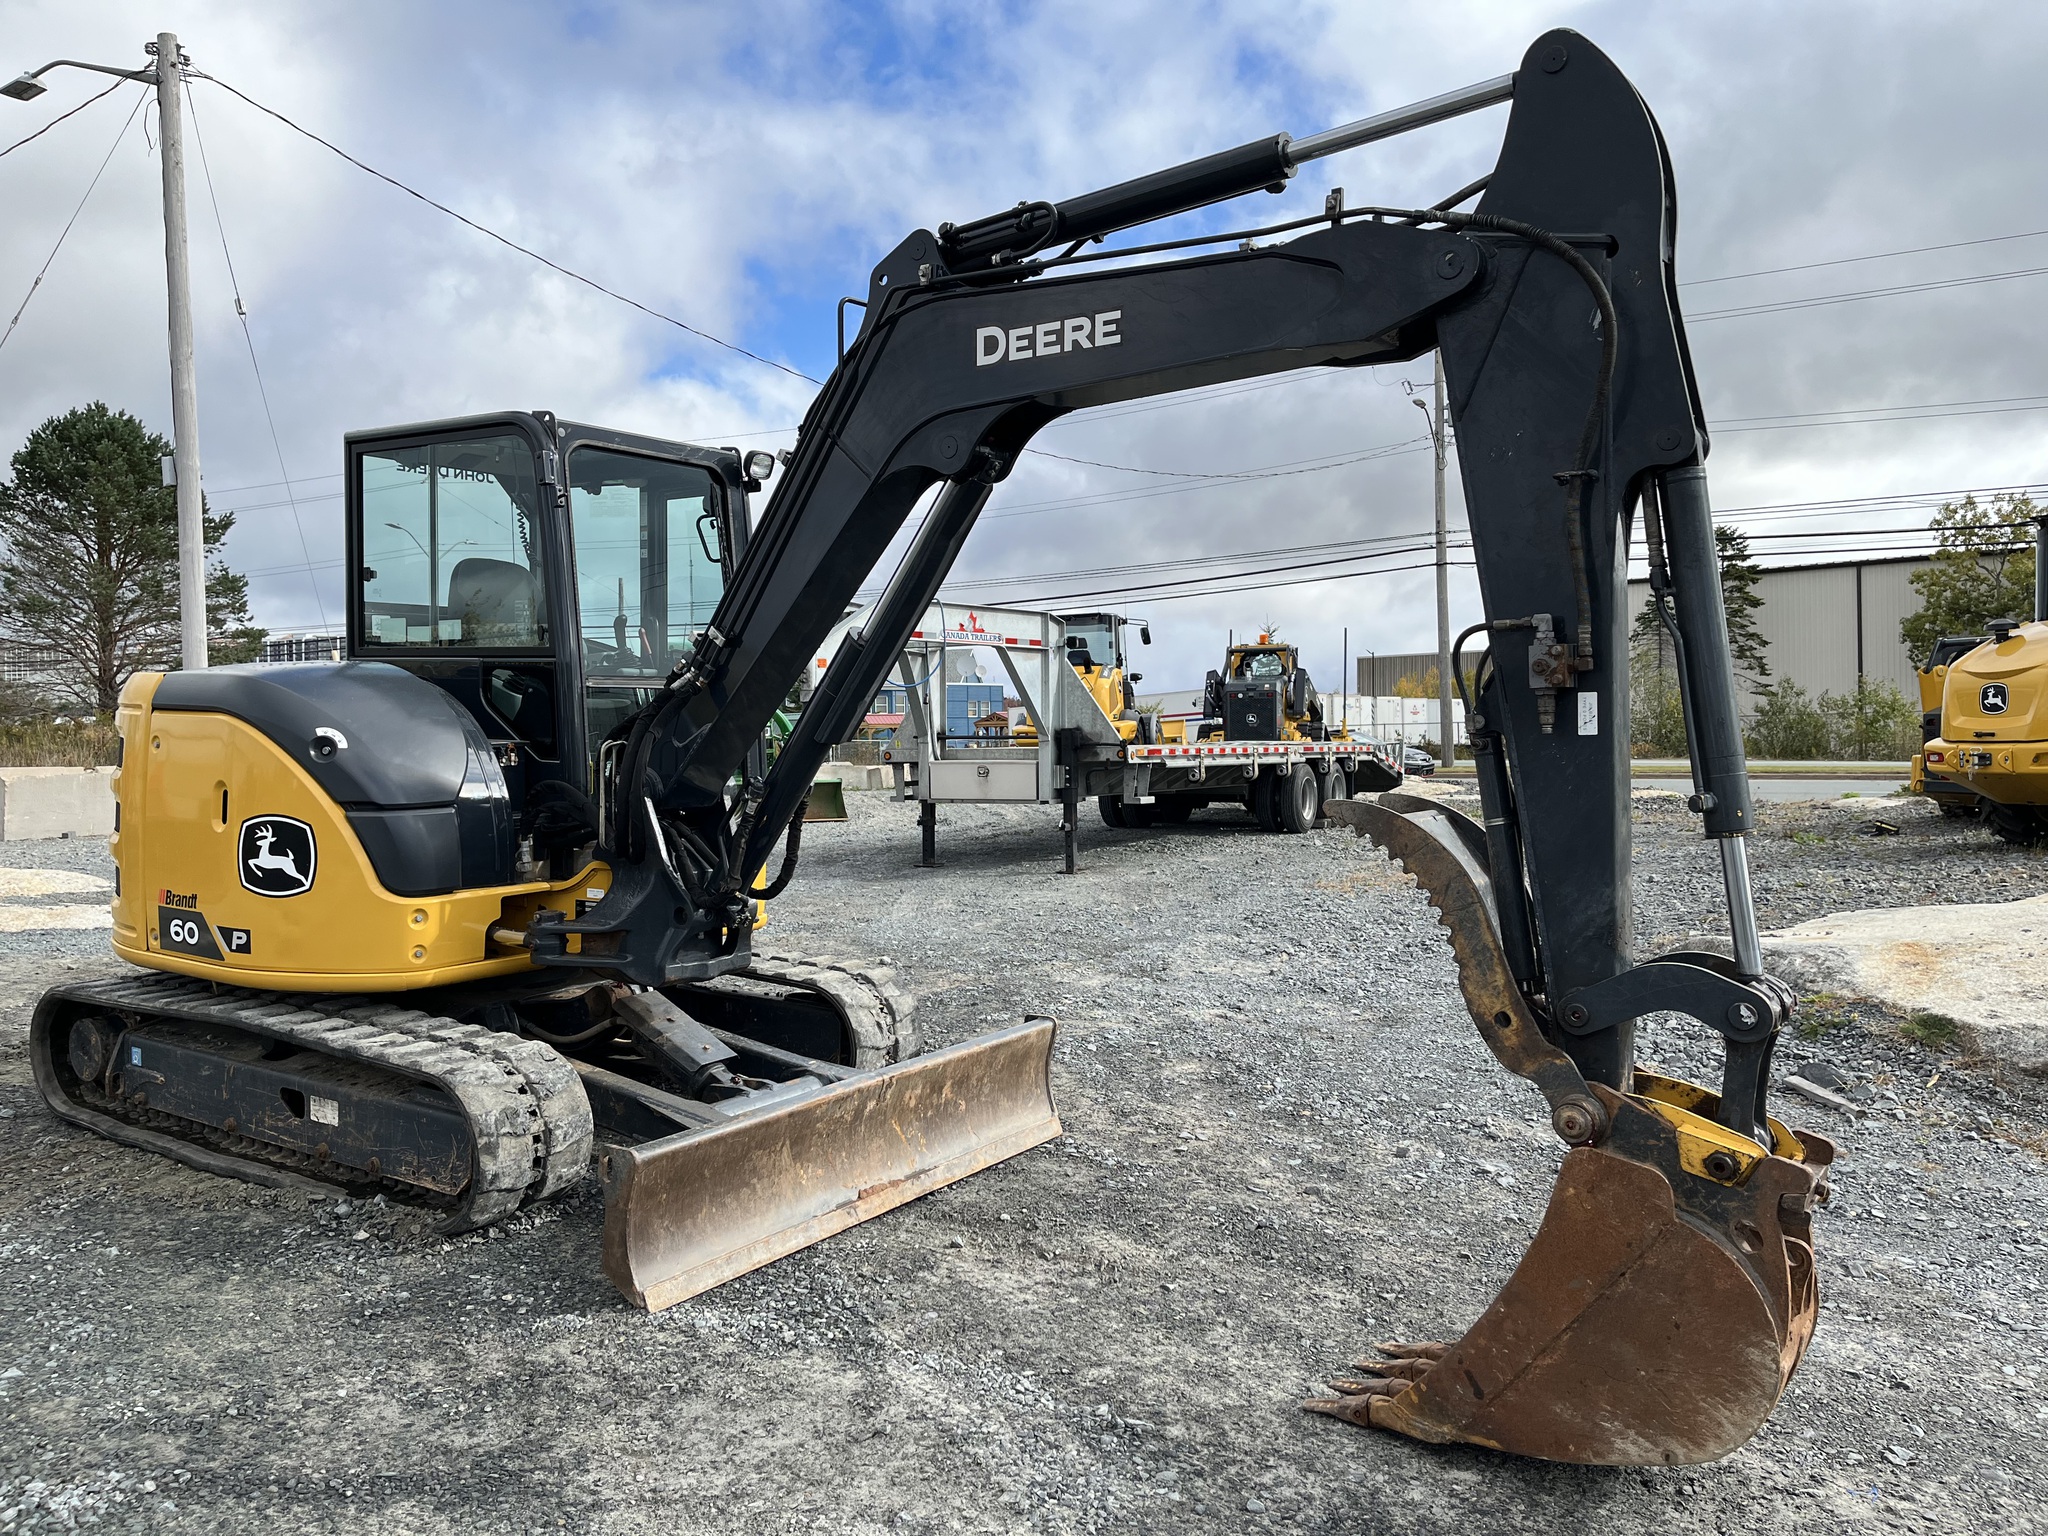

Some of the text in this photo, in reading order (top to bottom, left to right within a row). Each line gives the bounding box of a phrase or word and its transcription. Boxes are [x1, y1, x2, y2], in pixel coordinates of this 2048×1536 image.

[976, 310, 1121, 367] DEERE
[971, 633, 1001, 642] TRAILERS
[165, 889, 198, 909] Brandt
[170, 919, 199, 945] 60
[231, 931, 248, 950] P
